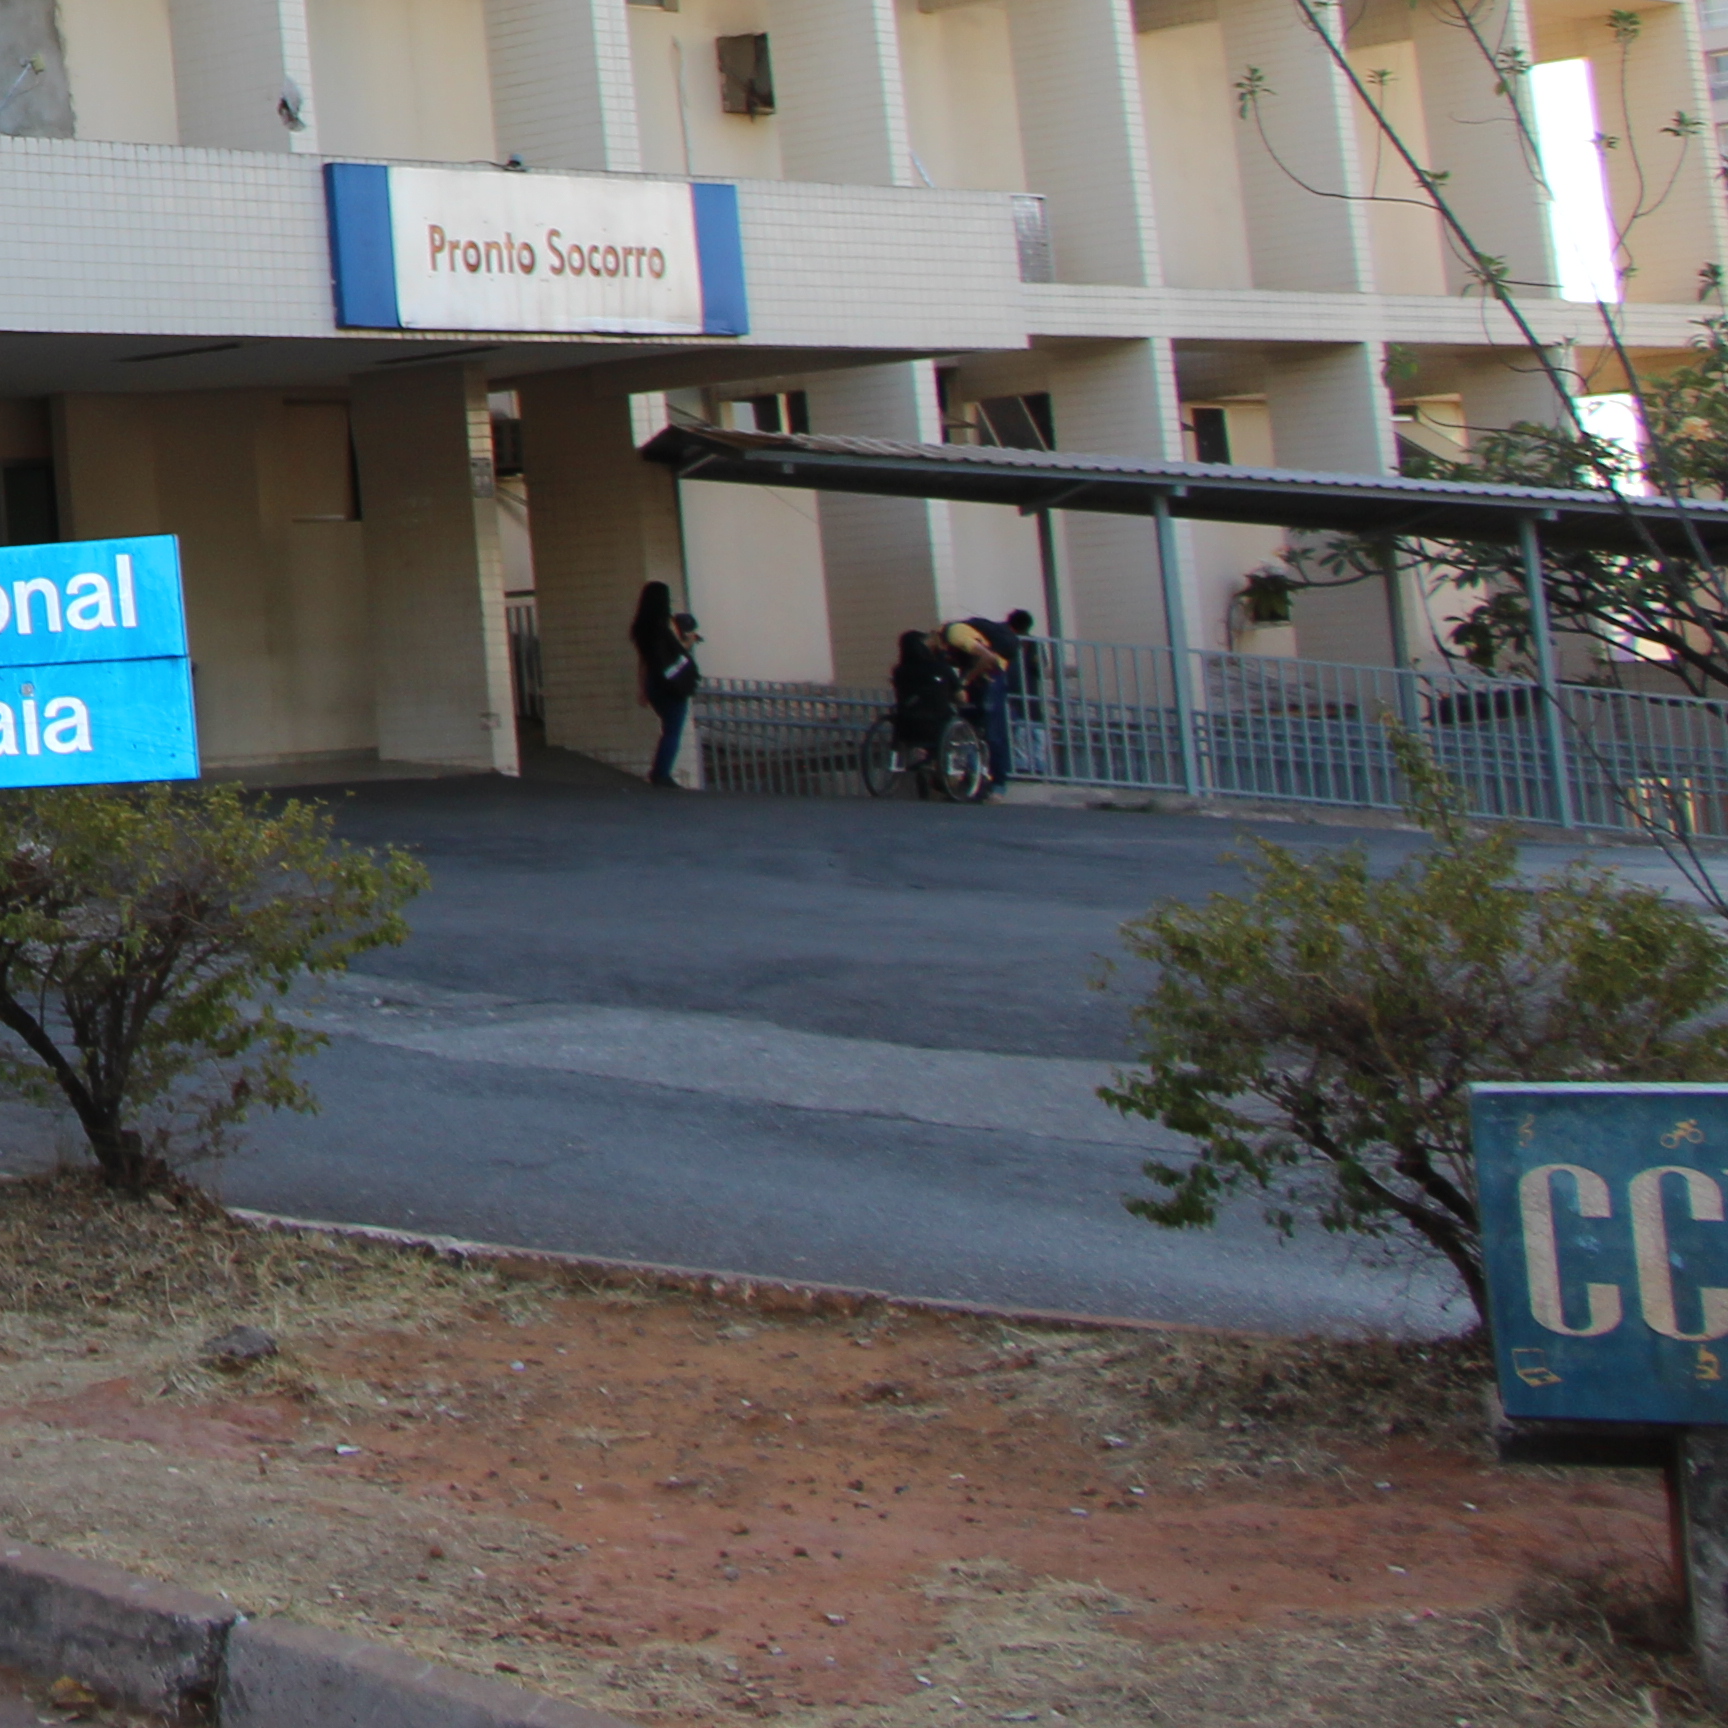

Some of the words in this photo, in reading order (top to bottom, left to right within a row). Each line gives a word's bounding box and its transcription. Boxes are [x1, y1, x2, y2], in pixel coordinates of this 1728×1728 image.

[428, 224, 536, 275] Pronto
[546, 228, 666, 279] Socorro
[1518, 1163, 1728, 1342] CC
